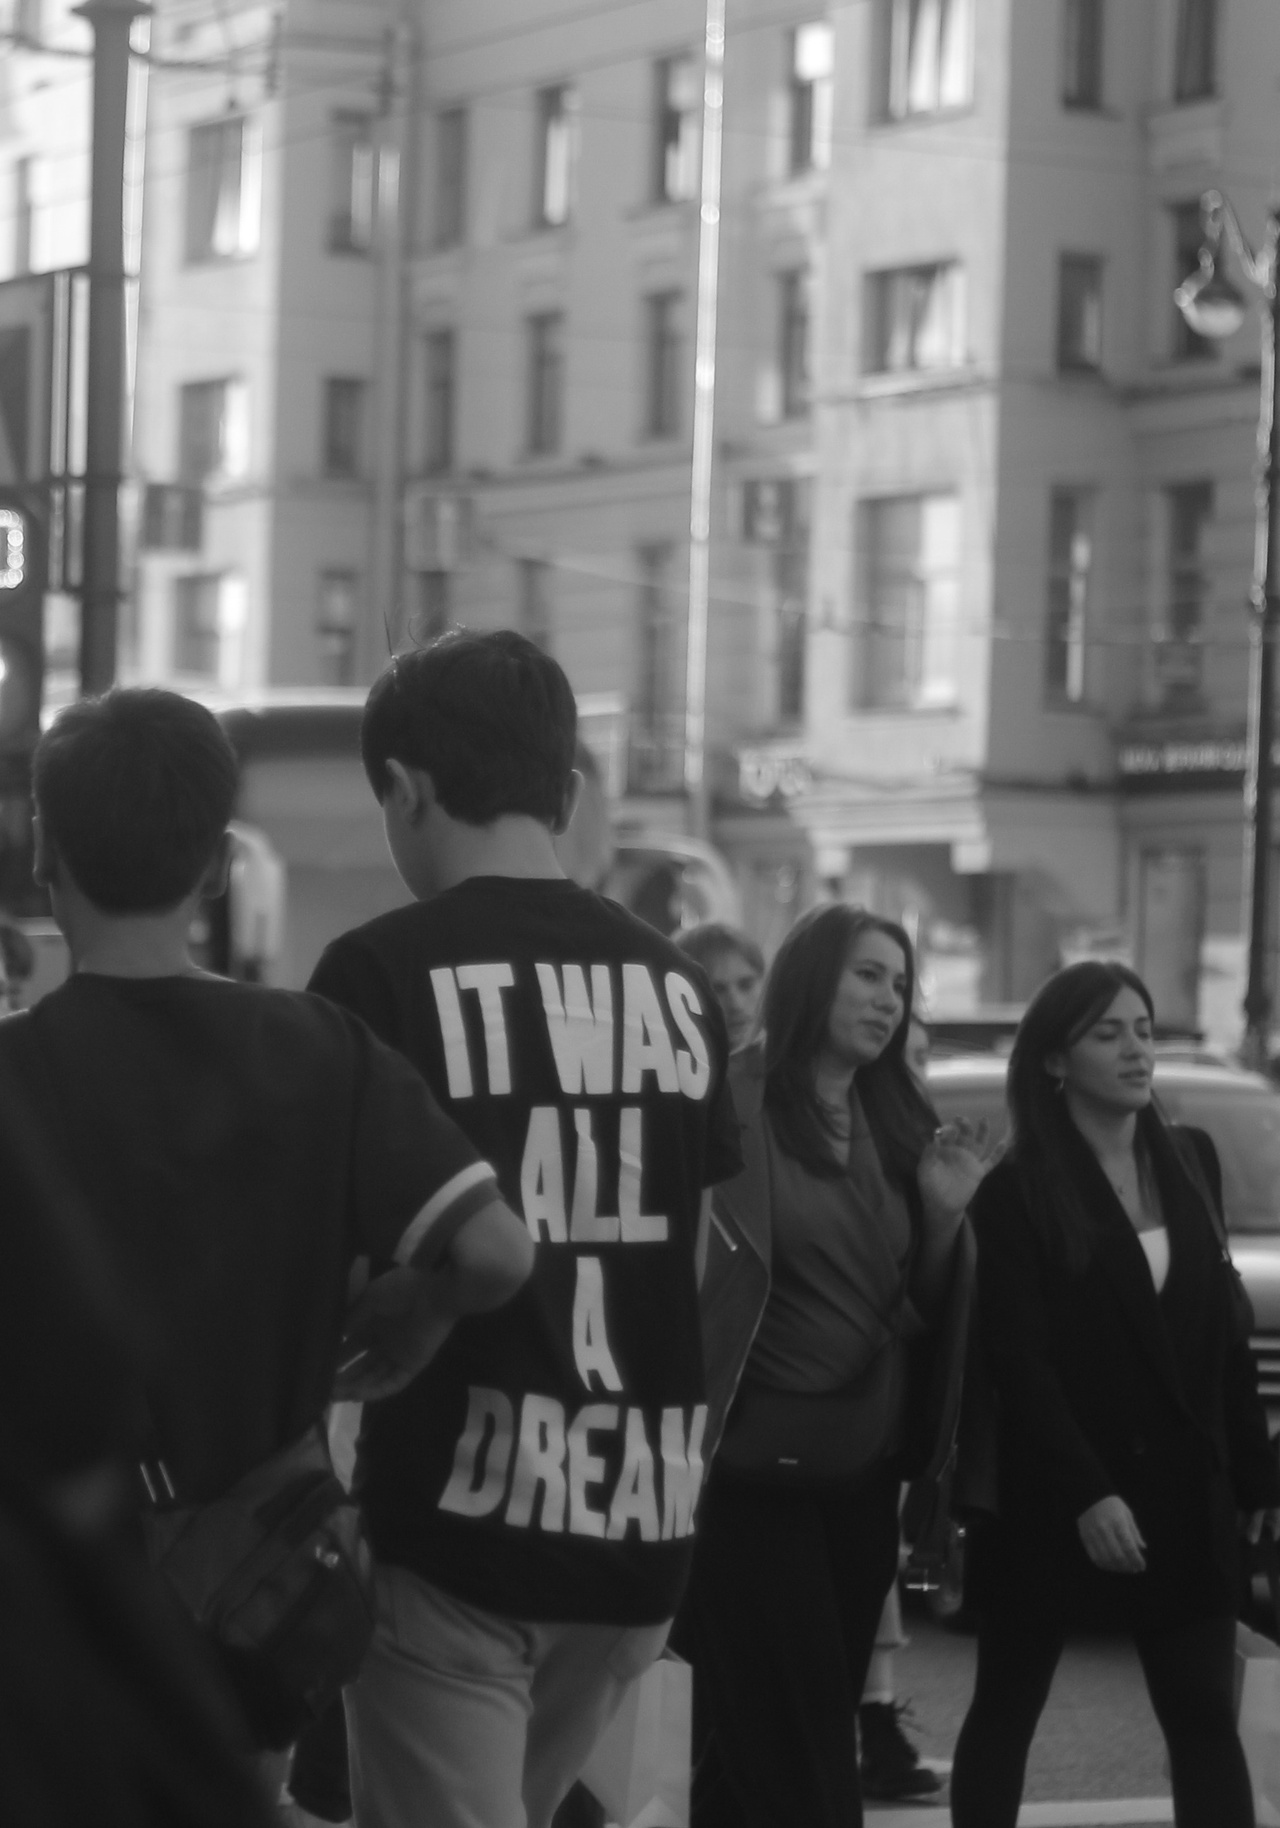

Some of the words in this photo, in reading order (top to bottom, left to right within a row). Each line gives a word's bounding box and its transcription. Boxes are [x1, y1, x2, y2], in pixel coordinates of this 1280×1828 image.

[430, 963, 515, 1099] IT
[535, 963, 710, 1100] WAS
[521, 1107, 668, 1243] ALL
[574, 1257, 623, 1391] A
[438, 1386, 708, 1541] DREAM
